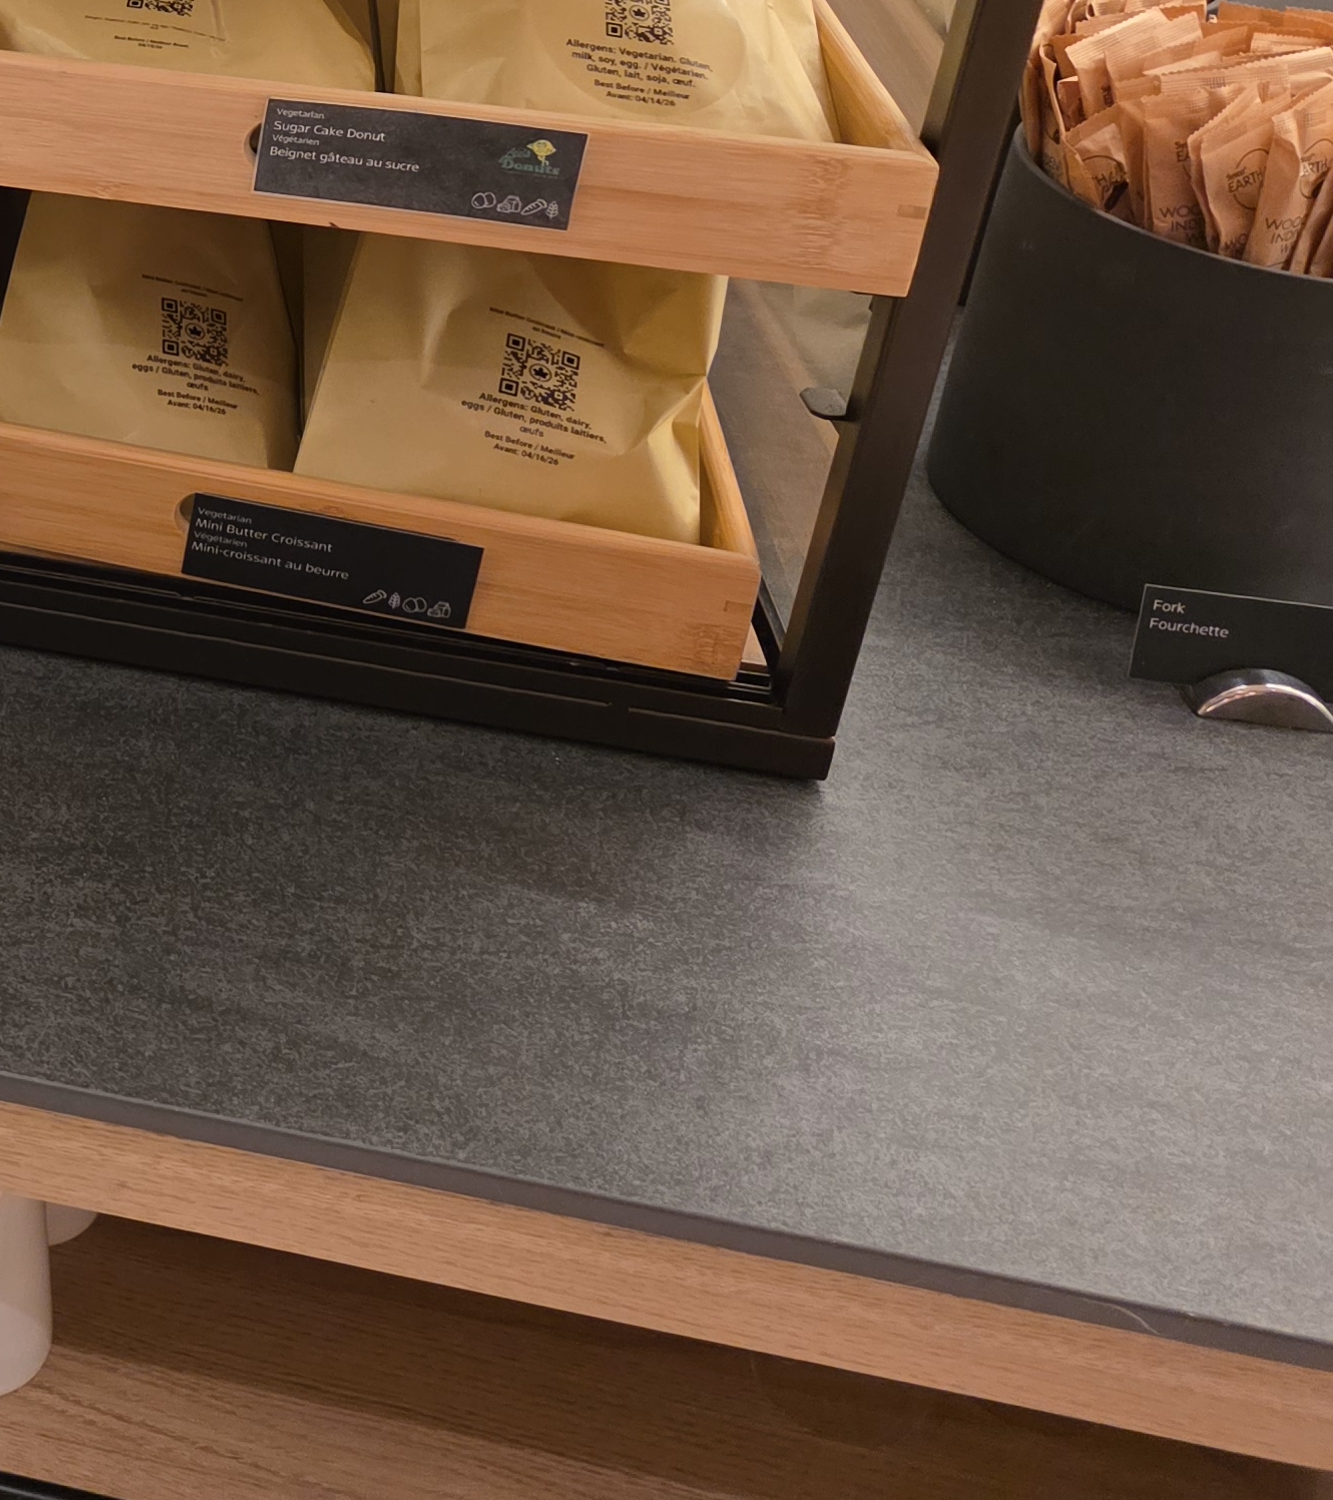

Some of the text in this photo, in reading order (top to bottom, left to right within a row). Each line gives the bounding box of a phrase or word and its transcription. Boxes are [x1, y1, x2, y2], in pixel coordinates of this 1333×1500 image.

[566, 38, 713, 72] Allergens: Vegetarian. Gluten,
[571, 51, 595, 62] milk,
[598, 56, 617, 66] soy,
[619, 60, 641, 70] egg.
[650, 63, 708, 80] Végétarien.
[586, 63, 696, 87] Gluten, lait, soja, œuf.
[594, 79, 614, 88] Best
[615, 82, 645, 93] Before
[653, 88, 690, 99] Meilleur
[634, 95, 676, 106] 04/14/26
[277, 108, 325, 119] Vegetarian
[272, 134, 320, 145] Végétarien
[273, 120, 385, 142] Sugar Cake Donut
[269, 146, 419, 172] Beignet gâteau au sucre
[496, 158, 562, 176] Donuts
[198, 507, 252, 524] Vegetarian
[194, 531, 247, 548] Végétarien
[195, 518, 332, 552] Mini Butter Croissant
[192, 541, 349, 579] Mini-croissant au beurre
[1153, 599, 1186, 614] Fork
[1149, 617, 1230, 638] Fourchette
